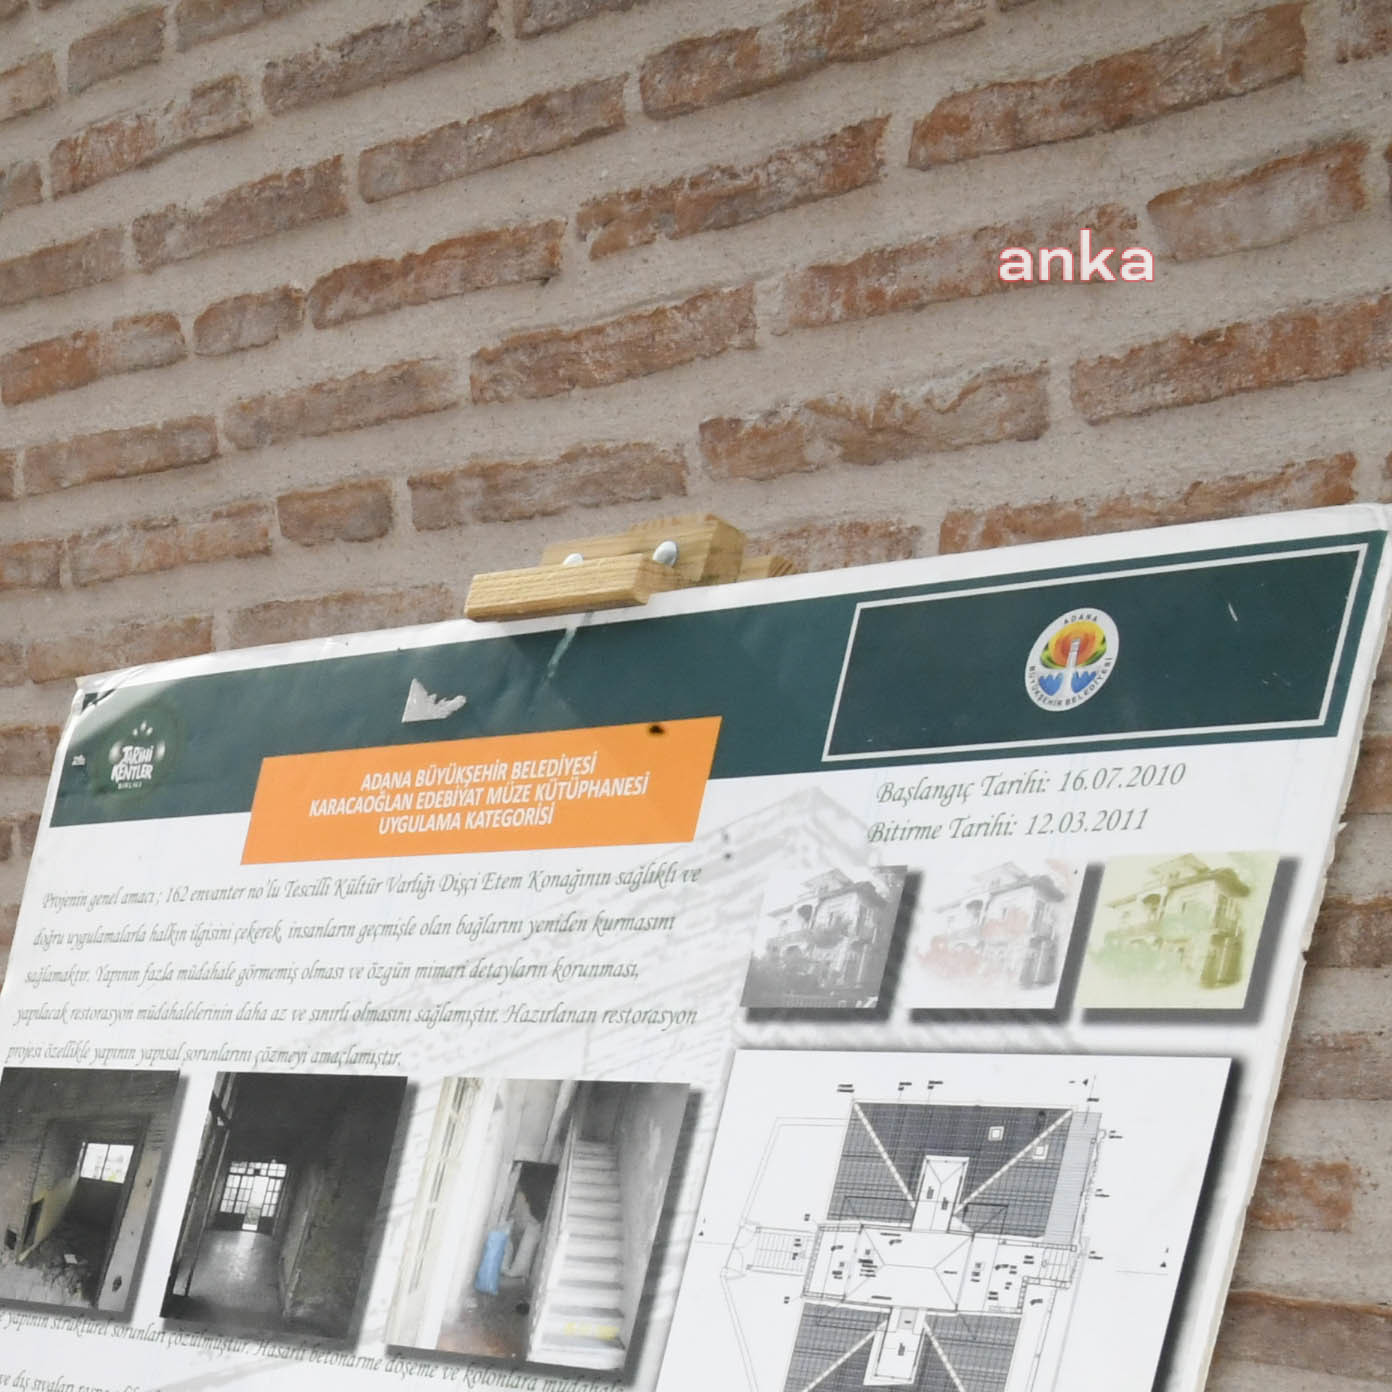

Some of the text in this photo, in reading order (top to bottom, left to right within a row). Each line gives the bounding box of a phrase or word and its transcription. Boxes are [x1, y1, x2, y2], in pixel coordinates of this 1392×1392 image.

[110, 763, 154, 782] KENTLER
[361, 752, 598, 792] ADANA BÜYÜKŞEHİR BELEDİYESİ
[876, 762, 1187, 807] Başlangıç Tarihi: 16.07.2010
[309, 771, 650, 817] KARACAOĞLAN EDEBİYAT MÜZE KÜTÜPHANESİ
[378, 804, 556, 834] UYGULAMA KATEGORİSİ
[866, 807, 1150, 843] Bitirme Tarihi: 12.03.2011
